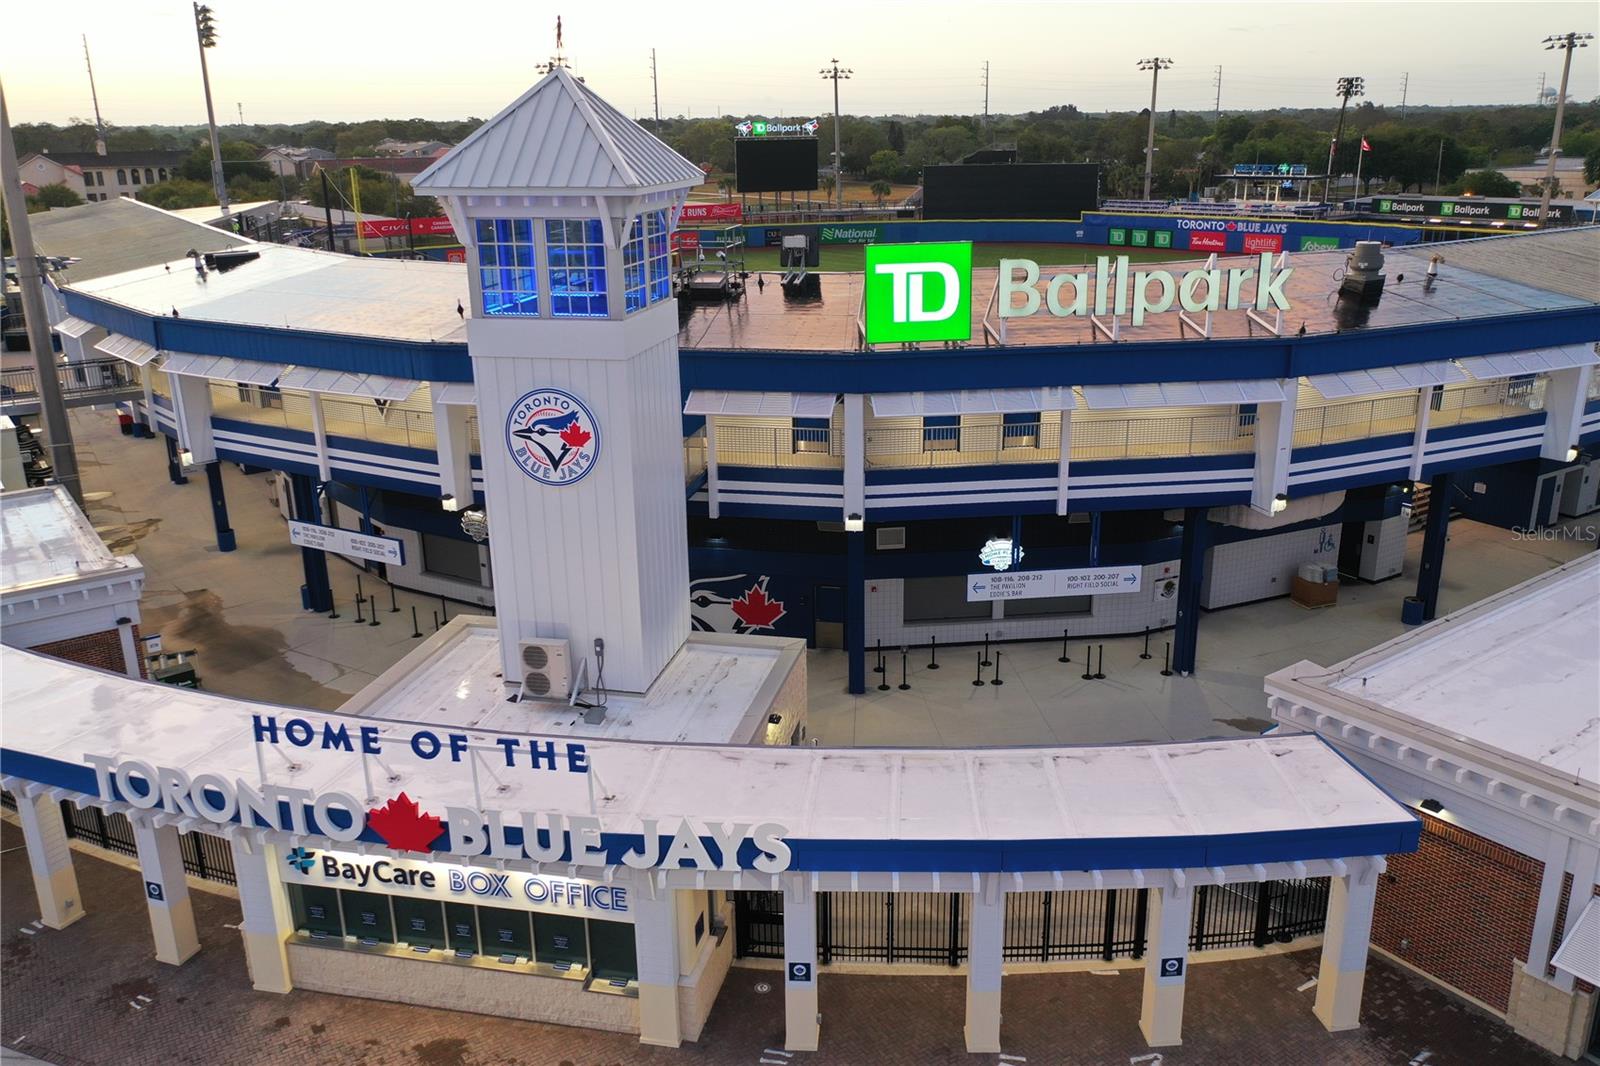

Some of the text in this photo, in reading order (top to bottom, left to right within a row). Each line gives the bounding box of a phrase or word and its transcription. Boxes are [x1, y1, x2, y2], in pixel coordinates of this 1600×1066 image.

[756, 123, 801, 133] TD Ballpark
[687, 207, 707, 217] RUNS
[1392, 202, 1424, 212] Ballpark
[1454, 205, 1490, 215] Ballpark
[1522, 207, 1561, 218] Ballark
[834, 228, 877, 238] National
[1177, 219, 1287, 234] TORONTO BLUE JAYS
[1191, 236, 1224, 247] Tim Hortons
[875, 251, 1296, 328] TD Ballpark
[513, 396, 570, 426] TORONTO
[515, 446, 591, 480] BLUE JAYS
[252, 714, 590, 774] HOME OF THE
[84, 751, 792, 874] TORONTO BLUE JAYS
[322, 854, 629, 912] BayCare BOX OFFICE
